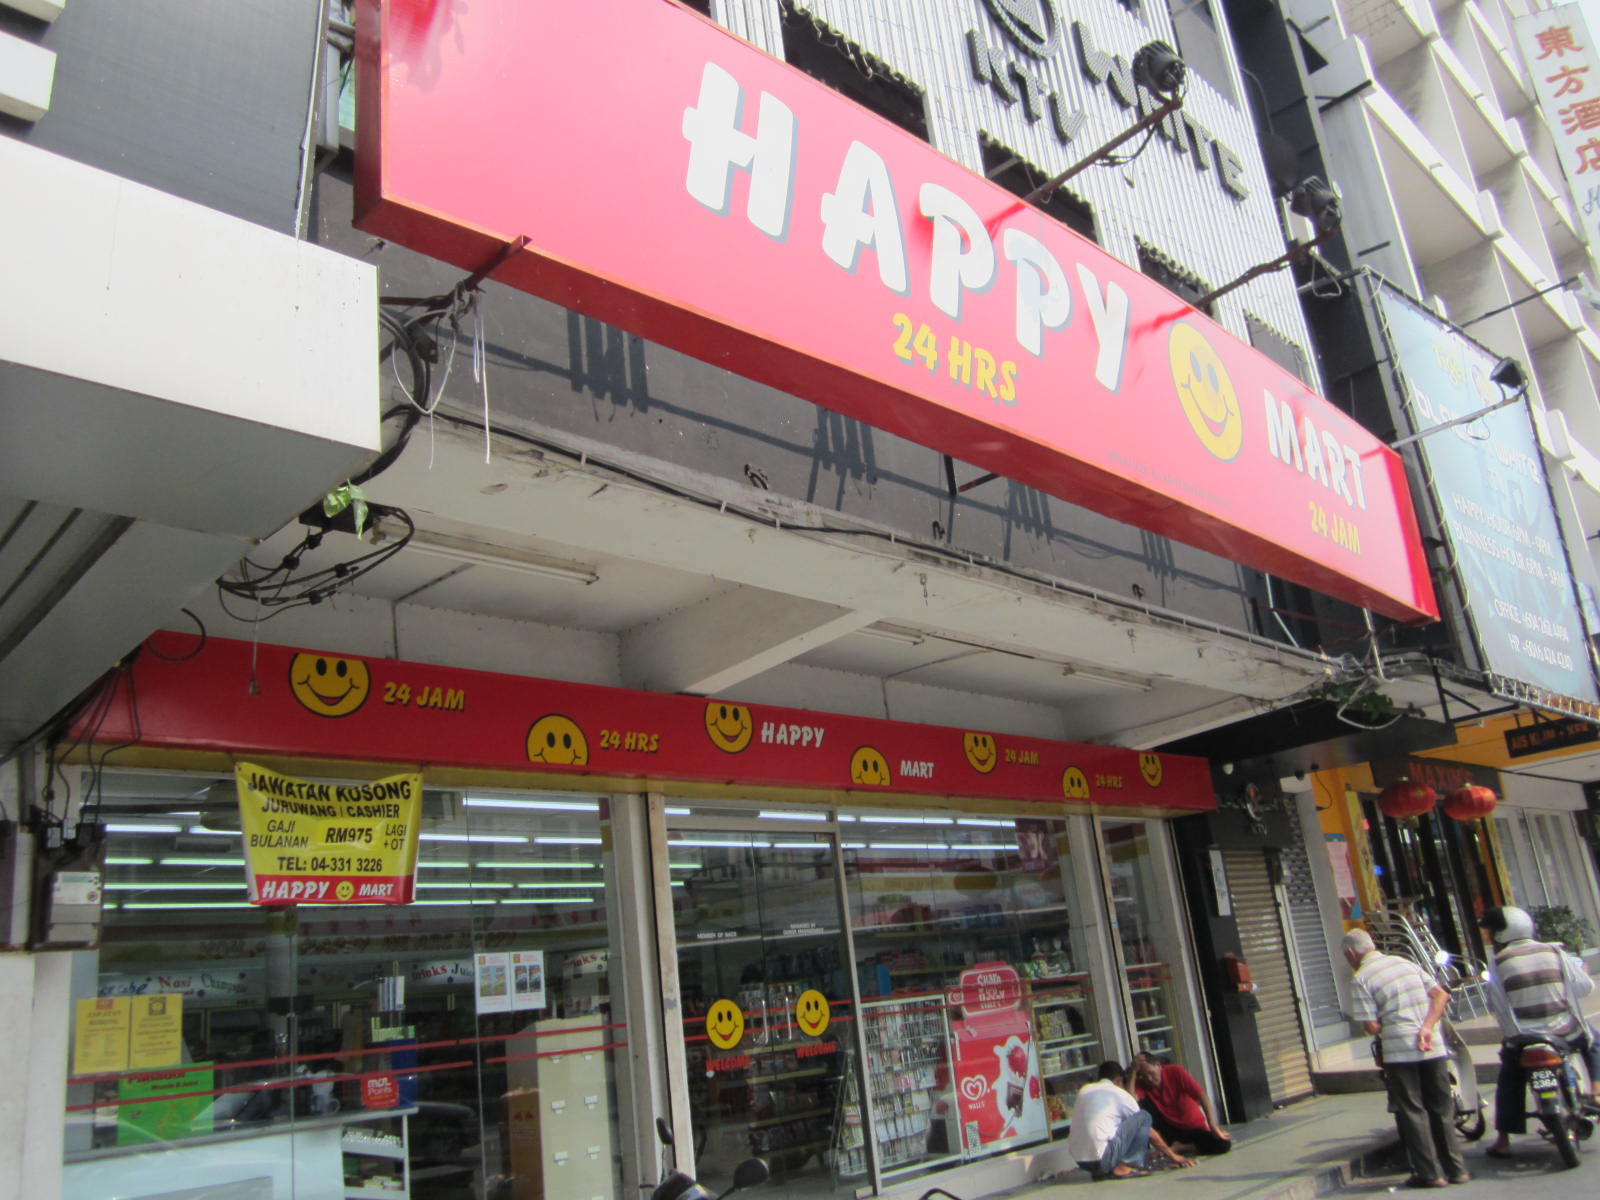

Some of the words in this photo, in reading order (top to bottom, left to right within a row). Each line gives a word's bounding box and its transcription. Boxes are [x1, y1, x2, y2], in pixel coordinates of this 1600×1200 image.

[682, 61, 1131, 394] HAPPY
[893, 313, 938, 377] 24
[948, 336, 1019, 406] HRS
[1264, 388, 1368, 513] MART
[1309, 501, 1329, 538] 24
[1331, 512, 1362, 556] JAM
[383, 681, 412, 705] 24
[416, 686, 466, 712] JAM
[600, 729, 622, 750] 24
[624, 731, 661, 754] HRS
[760, 722, 825, 749] HAPPY
[1018, 751, 1040, 767] JAM
[900, 760, 935, 780] MART
[248, 773, 331, 802] JAWATAN
[262, 798, 338, 818] JURUWANG
[346, 803, 401, 819] CASHIER
[267, 819, 296, 833] GAJI
[325, 827, 374, 845] RM975
[385, 824, 408, 837] LAGI
[250, 834, 309, 849] BULANAN
[391, 838, 406, 851] OT
[277, 856, 307, 871] TEL:
[311, 858, 352, 872] 04-331
[356, 858, 383, 873] 3226
[262, 880, 330, 900] HAPPY
[358, 883, 395, 898] MART
[158, 976, 193, 988] Nasi
[706, 1054, 752, 1073] WELCOME
